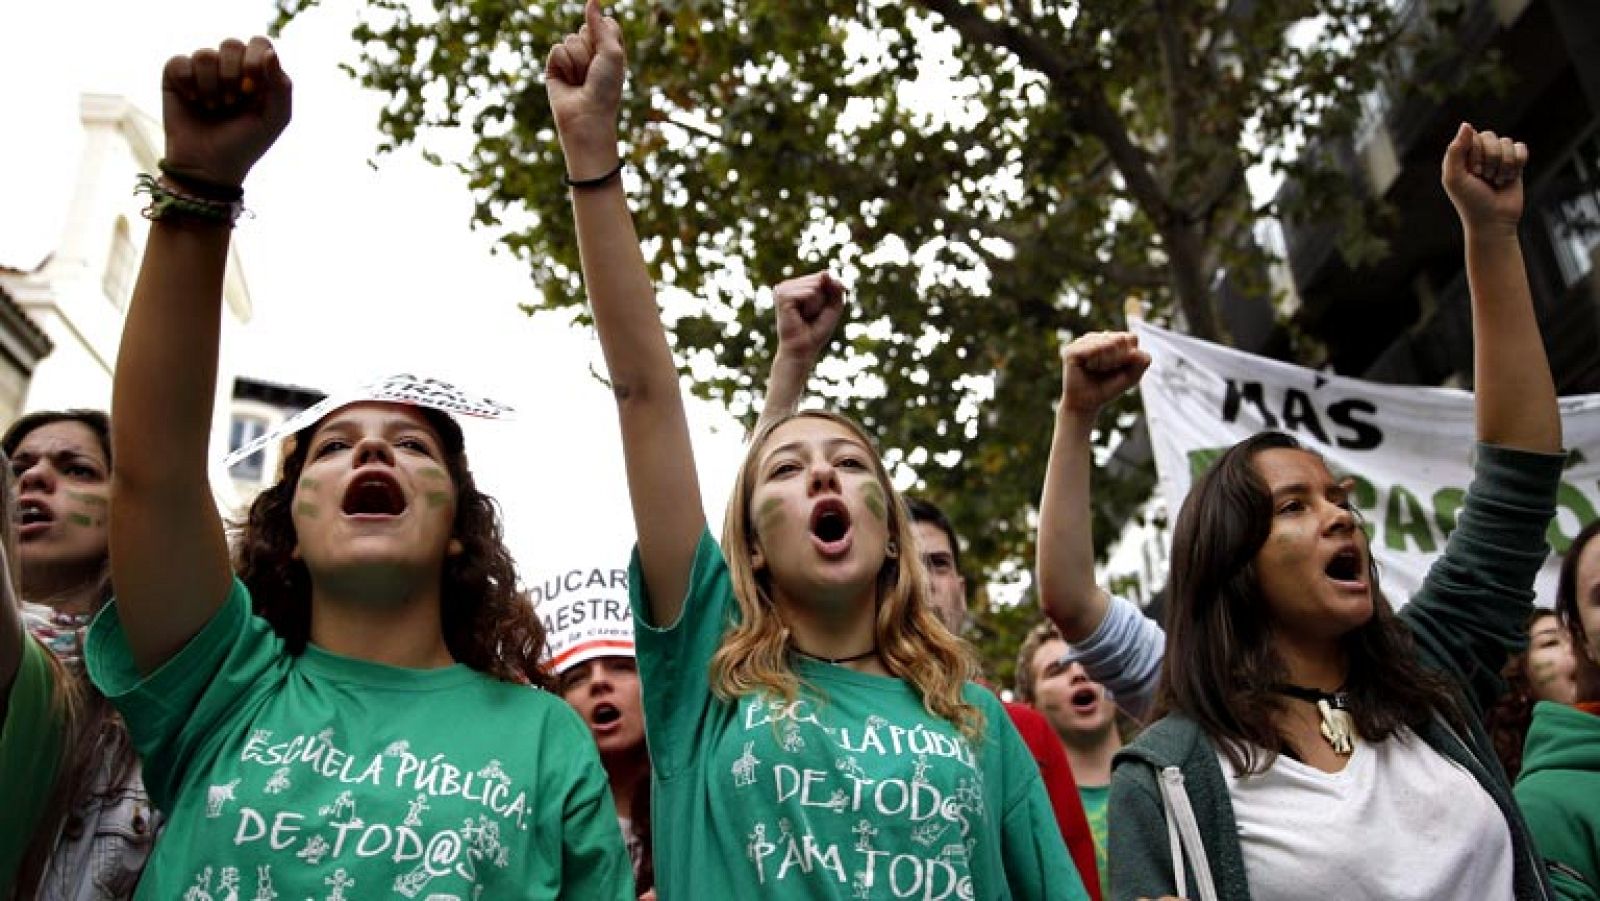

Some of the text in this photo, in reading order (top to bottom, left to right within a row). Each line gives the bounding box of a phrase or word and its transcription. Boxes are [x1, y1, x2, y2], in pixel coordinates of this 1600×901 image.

[1222, 375, 1383, 450] MÁS
[525, 568, 629, 608] DUCAR
[543, 597, 632, 635] AESTRA
[241, 735, 532, 830] ESCUELA PÚBLICA:
[773, 764, 832, 806] DE
[234, 807, 304, 849] DE
